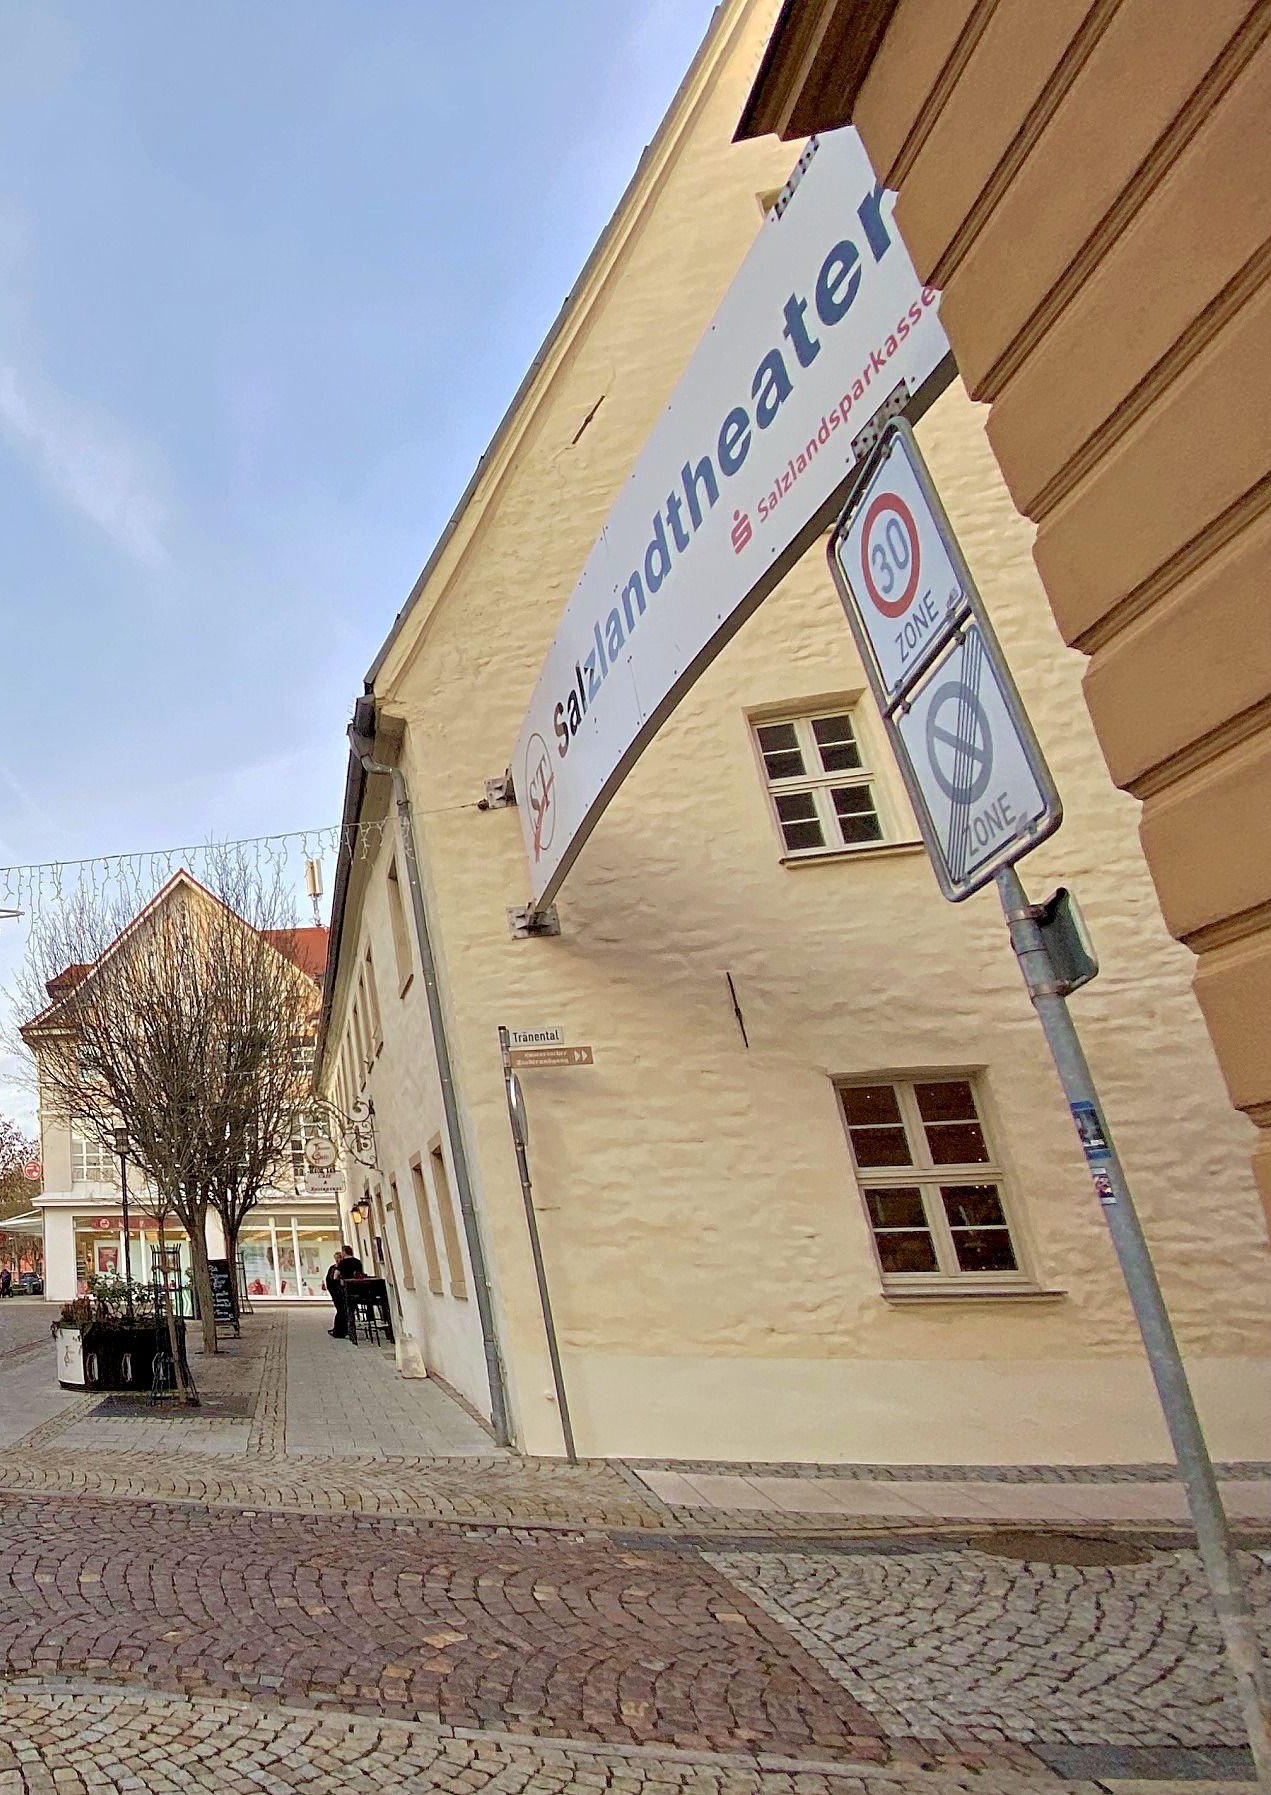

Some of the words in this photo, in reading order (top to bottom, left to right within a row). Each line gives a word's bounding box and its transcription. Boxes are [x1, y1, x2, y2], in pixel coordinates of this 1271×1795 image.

[757, 285, 935, 523] Salzlandsparkasse
[554, 181, 891, 759] Salzlandtheater
[872, 518, 910, 594] 30
[894, 590, 940, 663] ZONE
[963, 791, 1016, 857] ZONE
[512, 1029, 560, 1042] Tränental
